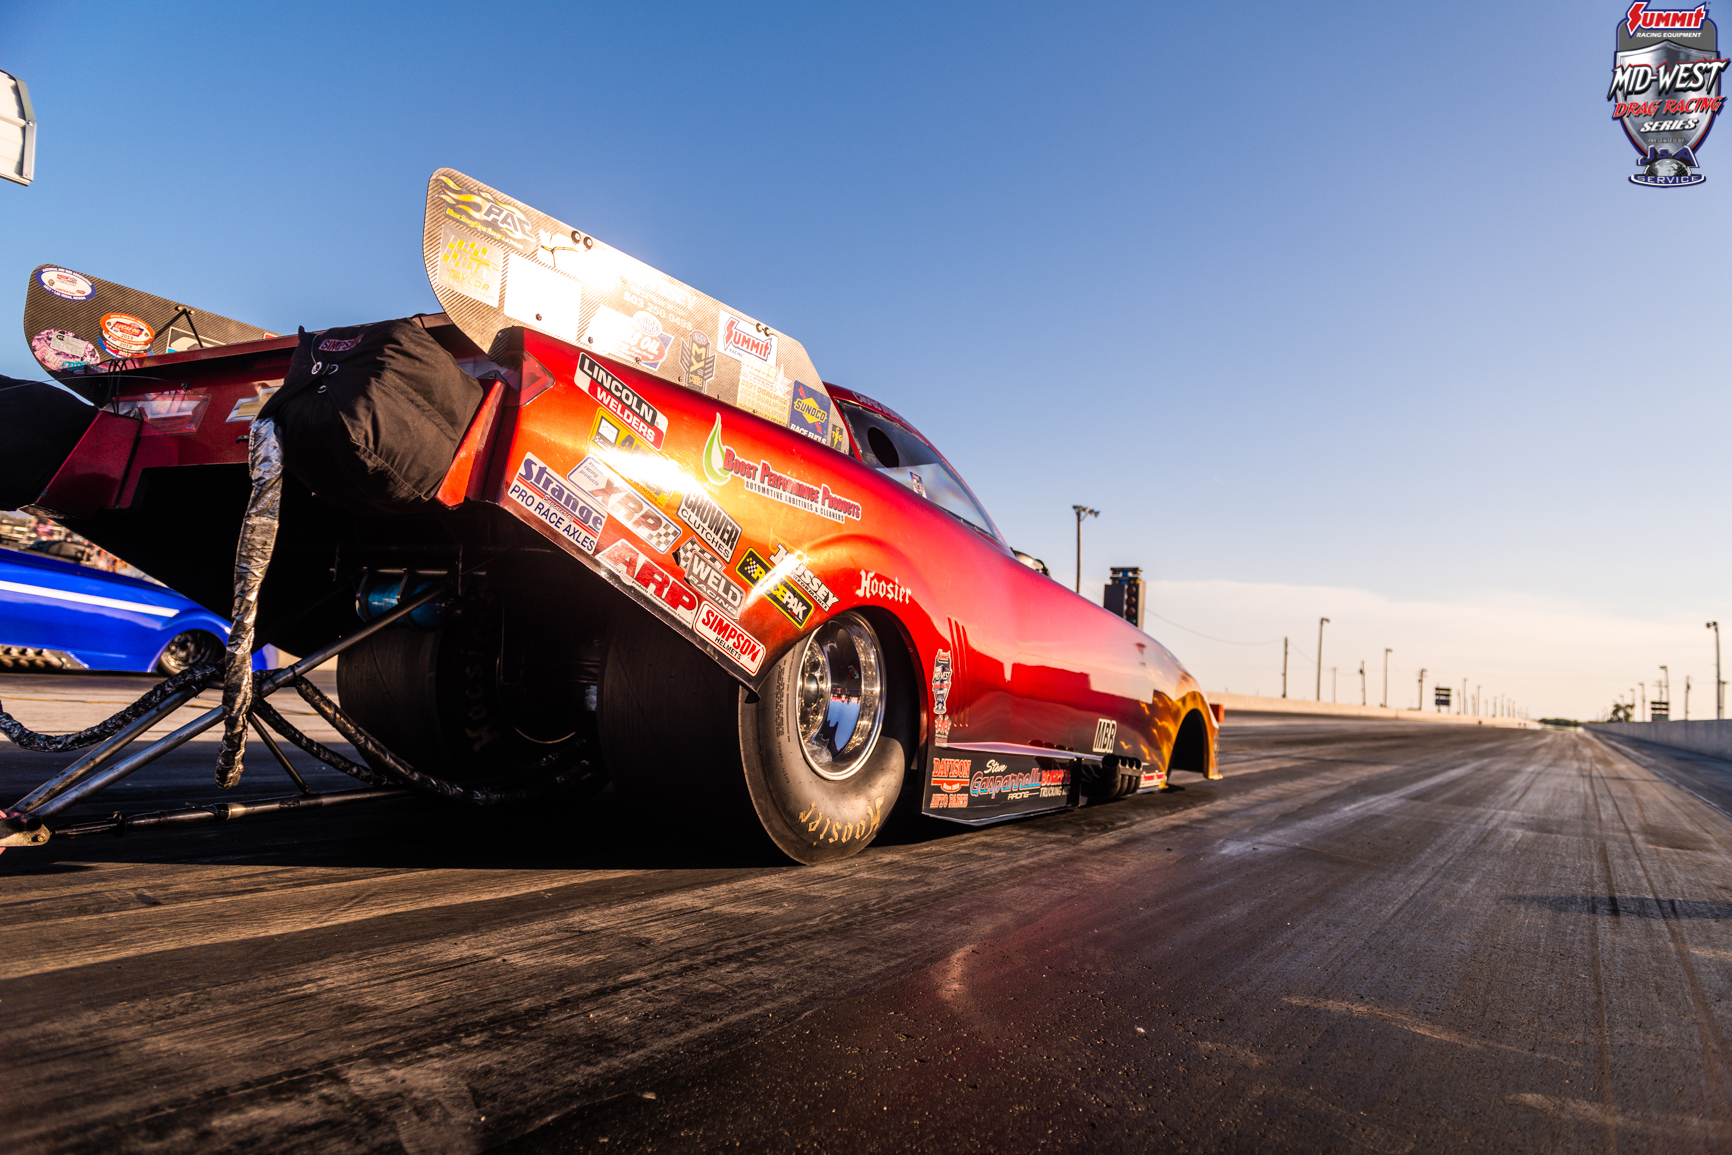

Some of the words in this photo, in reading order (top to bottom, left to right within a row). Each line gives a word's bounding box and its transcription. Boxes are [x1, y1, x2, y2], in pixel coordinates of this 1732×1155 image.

[482, 202, 537, 242] PAC
[448, 269, 490, 292] TAYLOR
[647, 301, 666, 318] 250
[668, 313, 693, 331] 0498
[117, 350, 132, 358] 2017
[120, 333, 134, 341] 2019
[640, 336, 661, 354] OIL
[582, 357, 656, 423] LINCOLN
[740, 387, 757, 399] 2020
[756, 394, 789, 414] QUALIFIER
[741, 379, 757, 390] 2021
[757, 385, 790, 406] QUALIFIER
[597, 387, 657, 443] WELDERS
[738, 395, 756, 406] 2019
[755, 402, 788, 422] QUALIFIER
[795, 399, 826, 422] SUNOCO
[789, 423, 809, 438] RACE
[518, 457, 604, 531] Strange
[588, 477, 663, 531] XRP
[745, 480, 783, 501] AUTOMOTIVE
[820, 507, 845, 523] CLEANERS
[510, 484, 535, 508] PRO
[534, 502, 565, 530] RACE
[563, 525, 596, 552] AXLES
[681, 508, 730, 559] CLUTCHES
[684, 491, 740, 551] CROWER
[600, 540, 698, 611] ARP
[691, 556, 743, 607] WELD
[752, 564, 808, 620] RCEPAK
[855, 569, 911, 605] Hoosier
[687, 574, 738, 615] RACING
[701, 608, 762, 663] SIMPSON
[714, 635, 742, 661] HELMETS
[1093, 718, 1117, 754] MBR
[932, 757, 972, 778] DAVISON
[930, 793, 948, 808] AUTO
[948, 793, 969, 808] PARTS
[1039, 785, 1062, 798] TRUCKING
[798, 796, 885, 846] Hoosier
